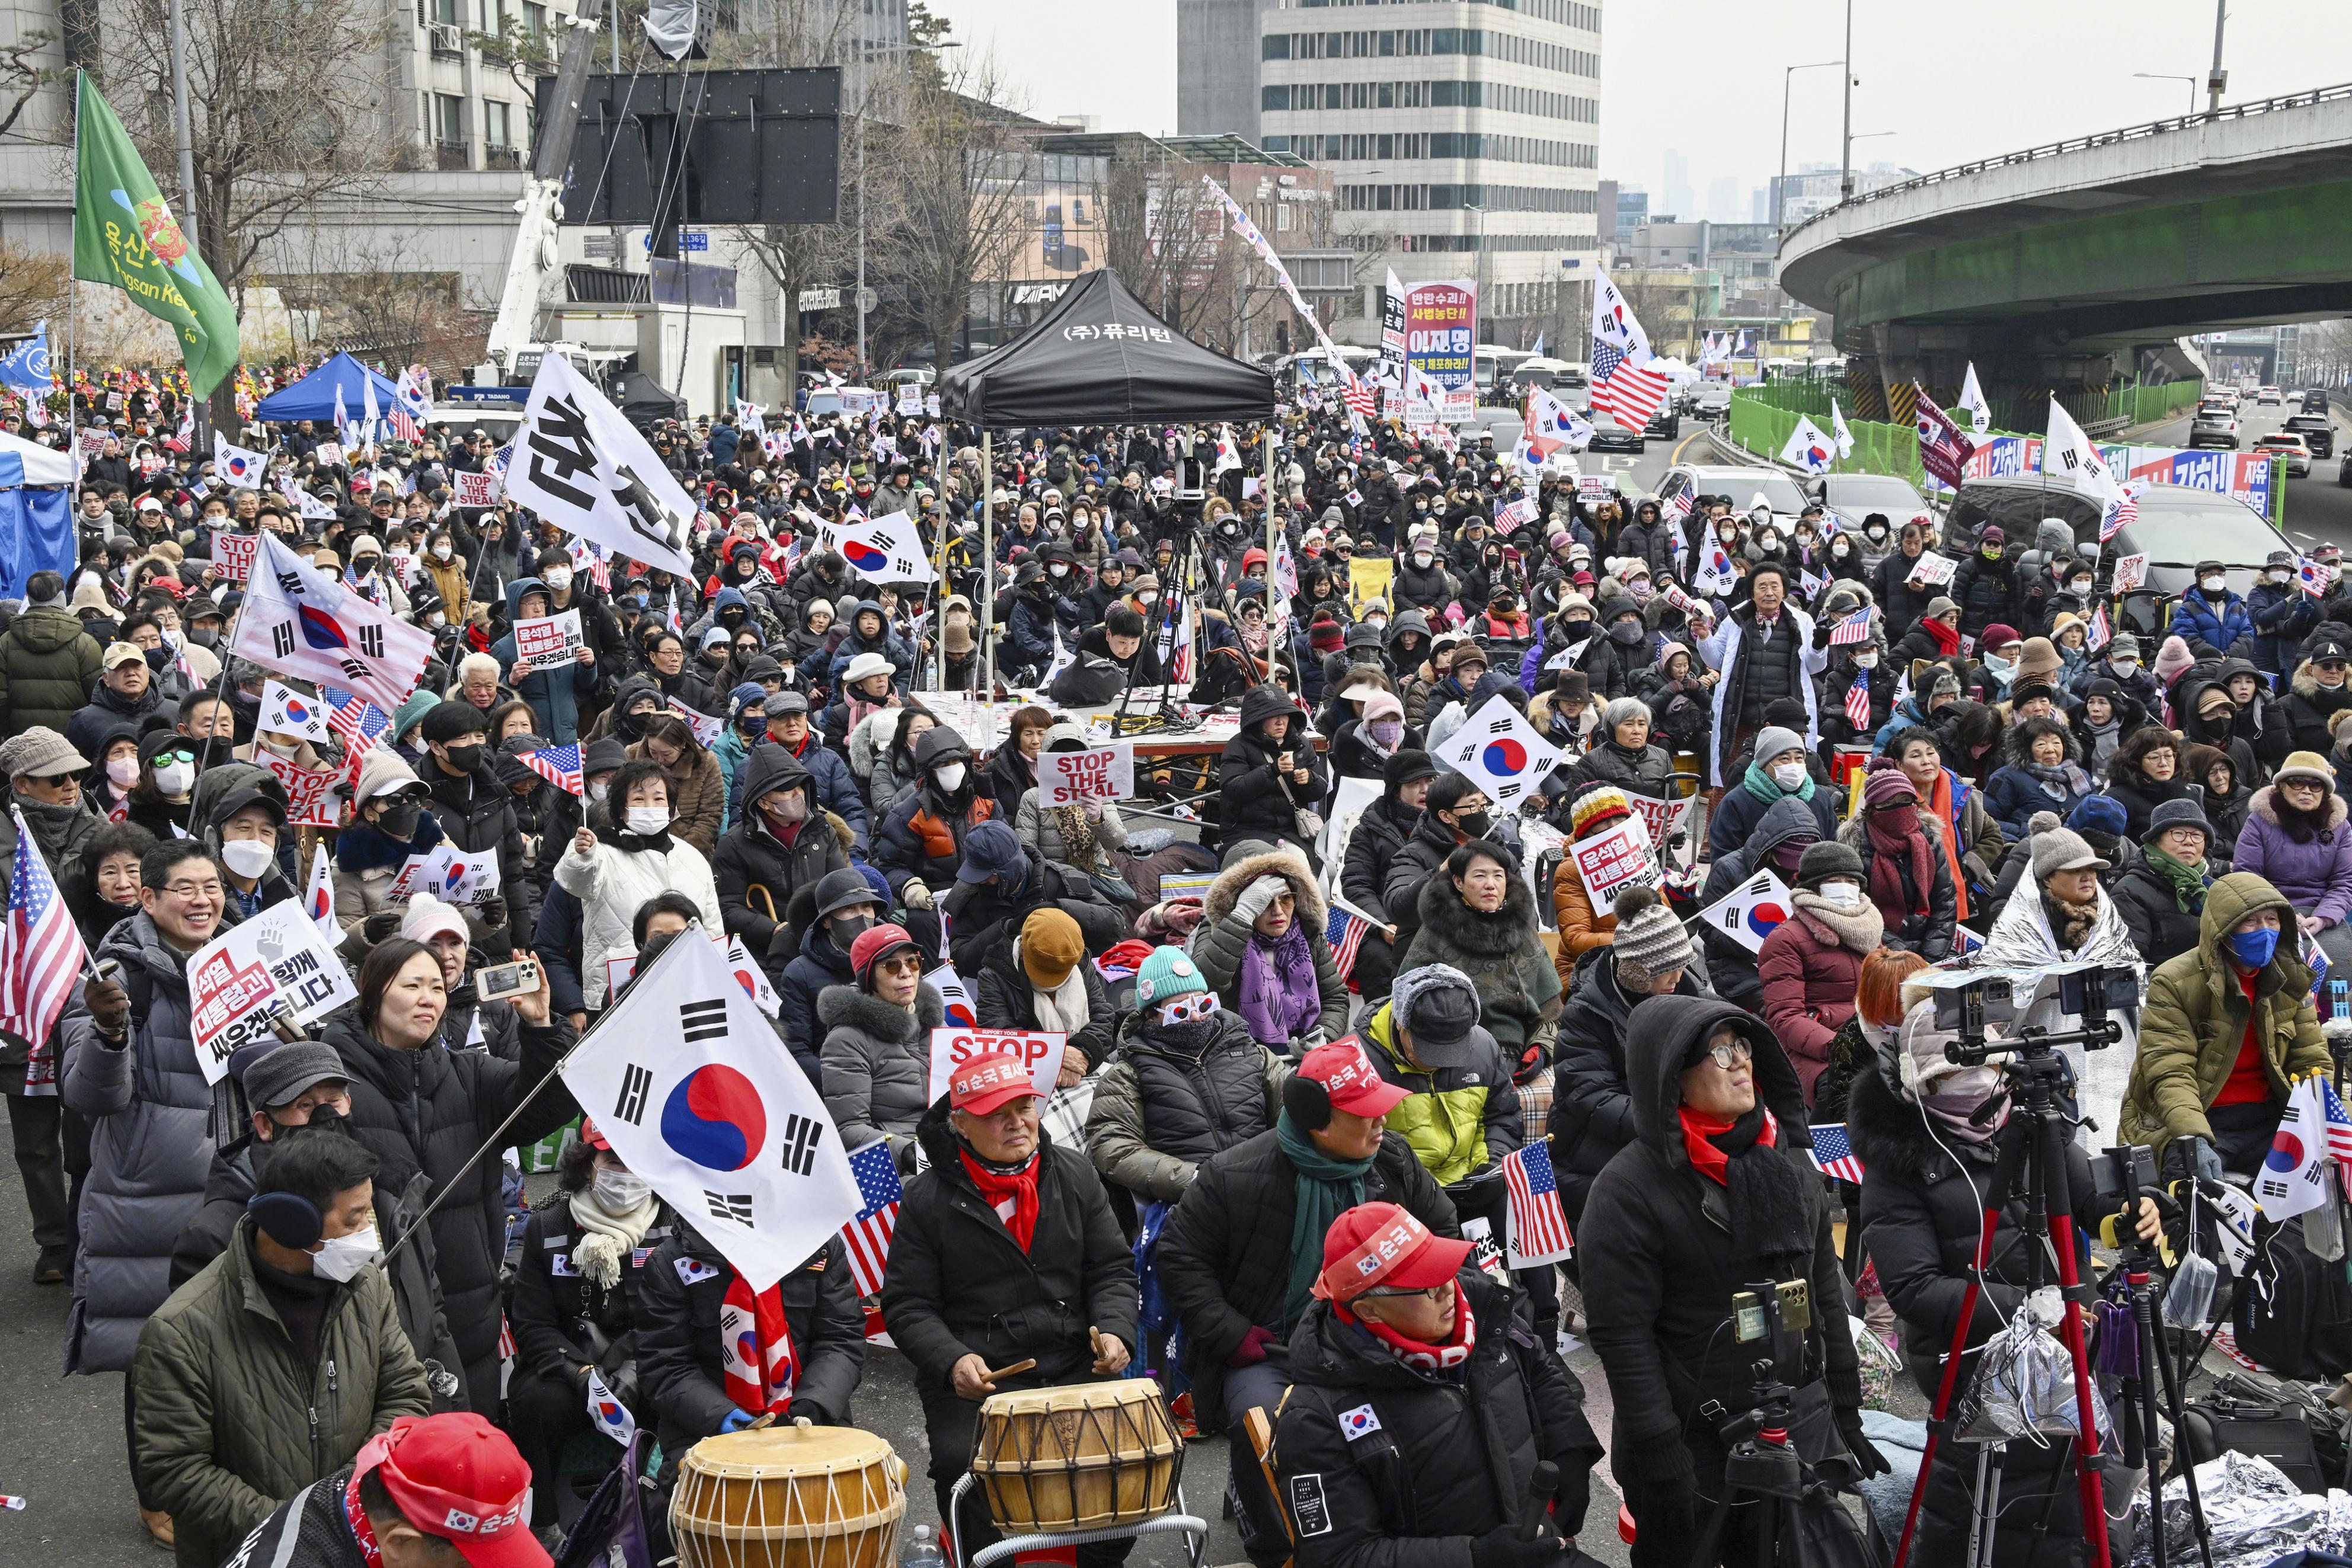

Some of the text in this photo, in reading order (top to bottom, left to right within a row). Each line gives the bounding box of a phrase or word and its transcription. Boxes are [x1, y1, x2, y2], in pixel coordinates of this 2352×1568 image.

[106, 222, 161, 268] 용산
[110, 255, 159, 298] Yngsan
[798, 284, 841, 312] ercedes-Benz
[1036, 284, 1071, 303] AM
[1412, 292, 1466, 305] 반란수괴!!
[1412, 308, 1467, 320] 사법농단!!
[1063, 323, 1172, 343] (주)퓨리턴
[1410, 330, 1469, 353] 이재명
[1433, 357, 1469, 370] 체포하라!!
[81, 434, 90, 452] STOP
[88, 439, 98, 451] THE
[95, 436, 106, 456] STEAL
[461, 475, 491, 485] STOP
[2244, 460, 2268, 485] 자유
[460, 495, 496, 505] STEAL
[465, 486, 488, 496] THE
[1507, 503, 1524, 513] STOP
[1513, 510, 1525, 518] THE
[220, 536, 255, 554] STO
[215, 563, 248, 580] STE
[392, 556, 410, 568] OP
[520, 624, 555, 641] 윤석열
[520, 633, 581, 654] 대통령과 함께
[2328, 643, 2338, 654] A
[1057, 750, 1116, 774] STOP
[269, 761, 340, 791] STOP
[1066, 769, 1108, 789] THE
[1053, 782, 1120, 802] STEAL
[286, 804, 333, 825] EAL
[1632, 799, 1684, 820] STOP
[1581, 839, 1629, 871] 윤석열
[1588, 847, 1646, 887] 대통령과
[194, 948, 321, 1038] 대통령과 함께
[1141, 981, 1150, 989] STOP
[1141, 989, 1152, 998] STEAL
[950, 1036, 1049, 1069] STOP
[969, 1067, 998, 1090] 순국
[1330, 1064, 1358, 1090] 순국
[1378, 1224, 1411, 1261] 순국
